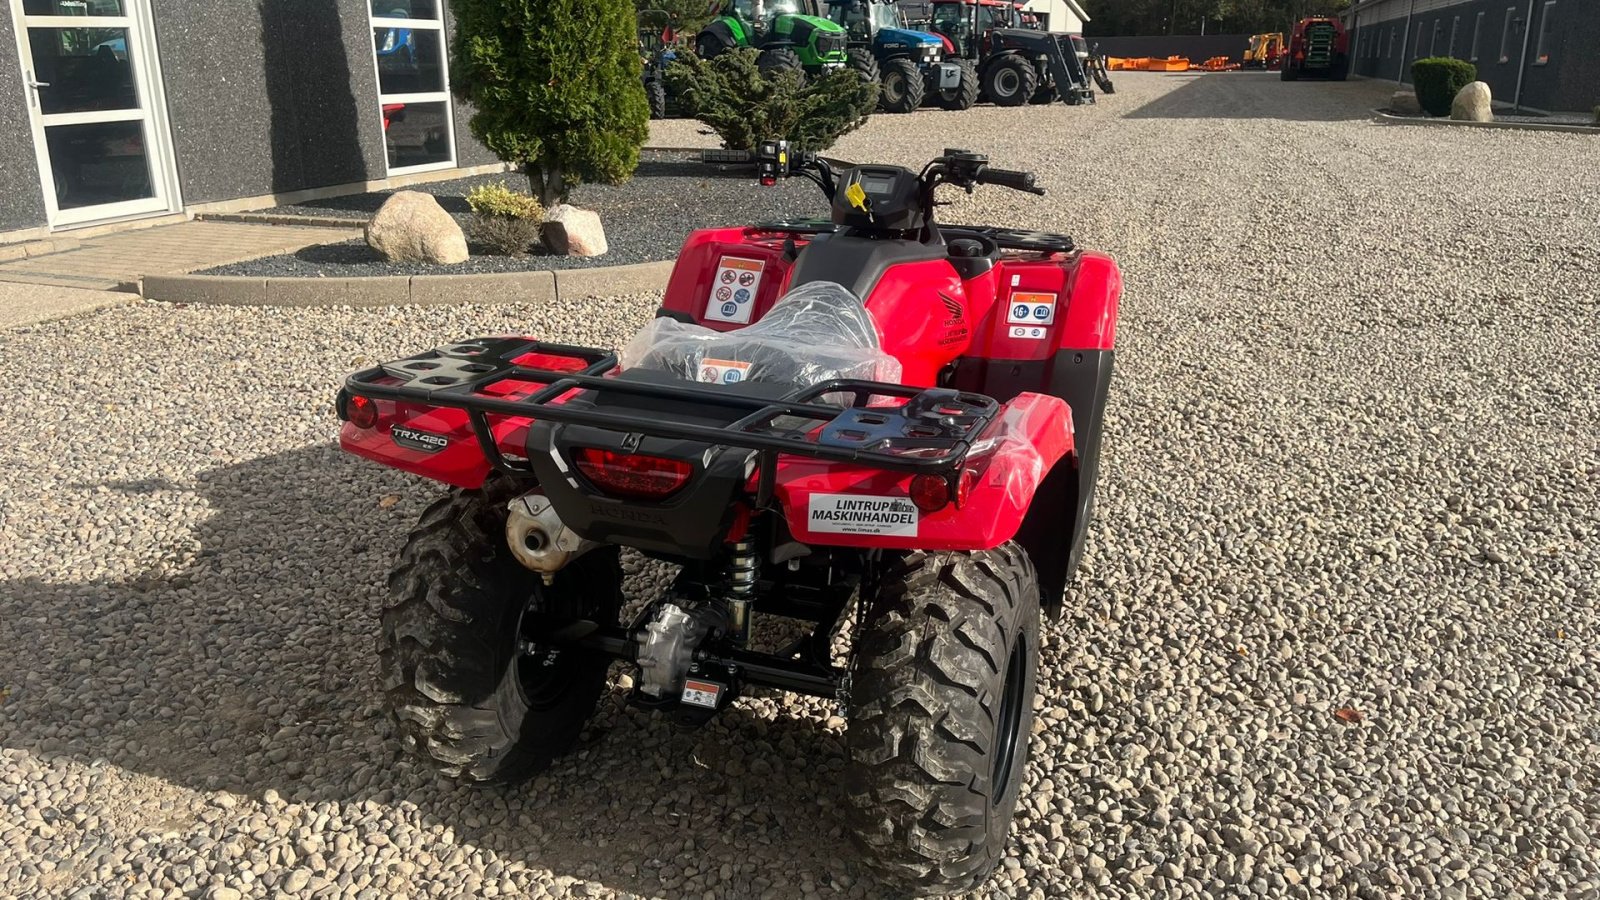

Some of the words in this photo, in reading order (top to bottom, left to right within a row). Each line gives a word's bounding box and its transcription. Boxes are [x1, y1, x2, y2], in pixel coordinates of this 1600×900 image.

[1015, 306, 1028, 317] 16+
[944, 319, 965, 327] HONDA
[393, 428, 448, 446] TRX420
[836, 500, 890, 512] LINTRUP
[591, 505, 669, 525] HONDA
[812, 510, 915, 524] MASKINHANDEL
